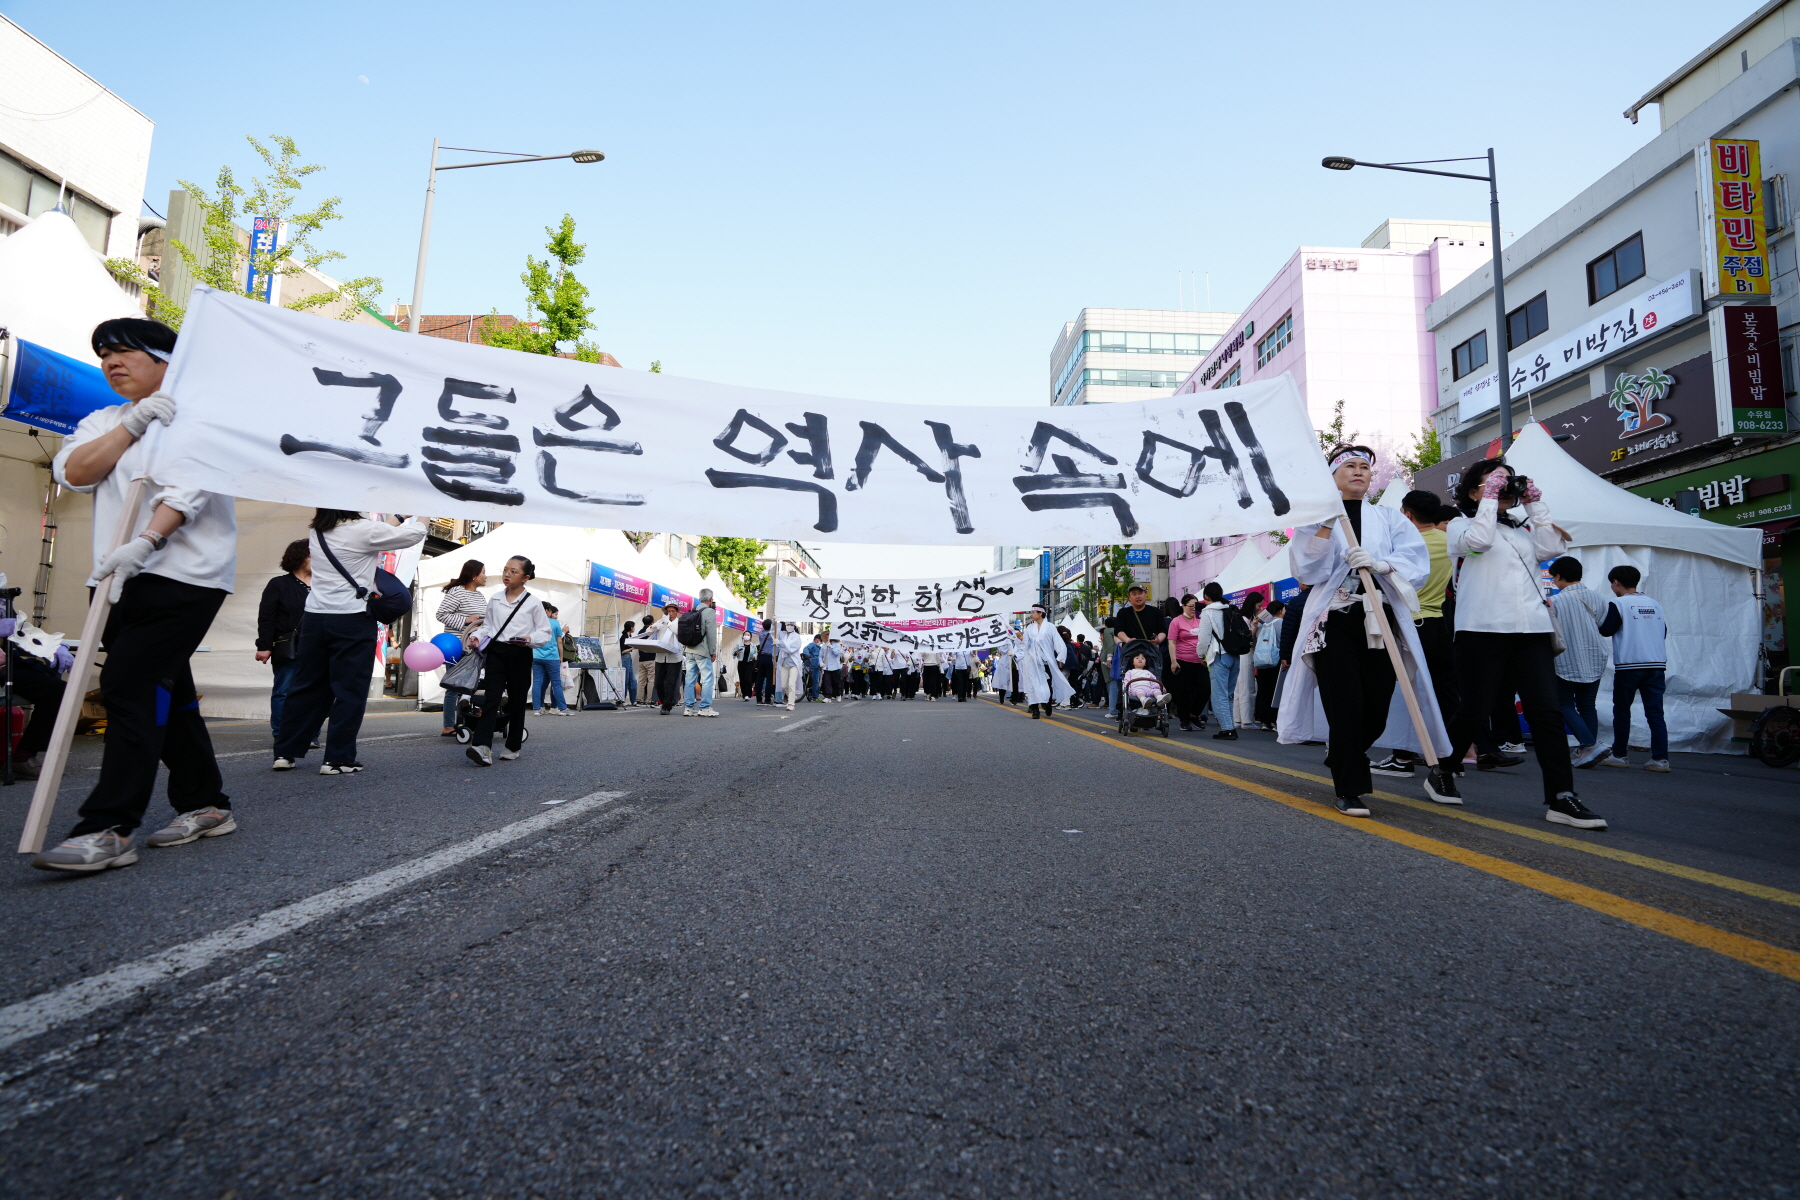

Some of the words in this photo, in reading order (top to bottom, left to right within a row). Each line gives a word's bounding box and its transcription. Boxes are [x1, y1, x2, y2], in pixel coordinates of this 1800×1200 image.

[1716, 143, 1756, 250] 비타민
[1722, 255, 1763, 277] 주점
[1735, 278, 1754, 293] B1
[1511, 353, 1551, 392] 수유
[1563, 308, 1639, 363] 미박집
[1741, 311, 1768, 401] 본죽&비빔밥
[1737, 421, 1784, 431] 908-6233
[1747, 410, 1772, 421] 수유점
[279, 366, 647, 506] 그들은
[705, 408, 981, 534] 역사
[1012, 402, 1291, 537] 속에
[1610, 447, 1626, 462] 2F
[1626, 431, 1681, 456] 노래연습장
[1735, 511, 1755, 521] 수유점
[800, 583, 900, 620] 장엄한
